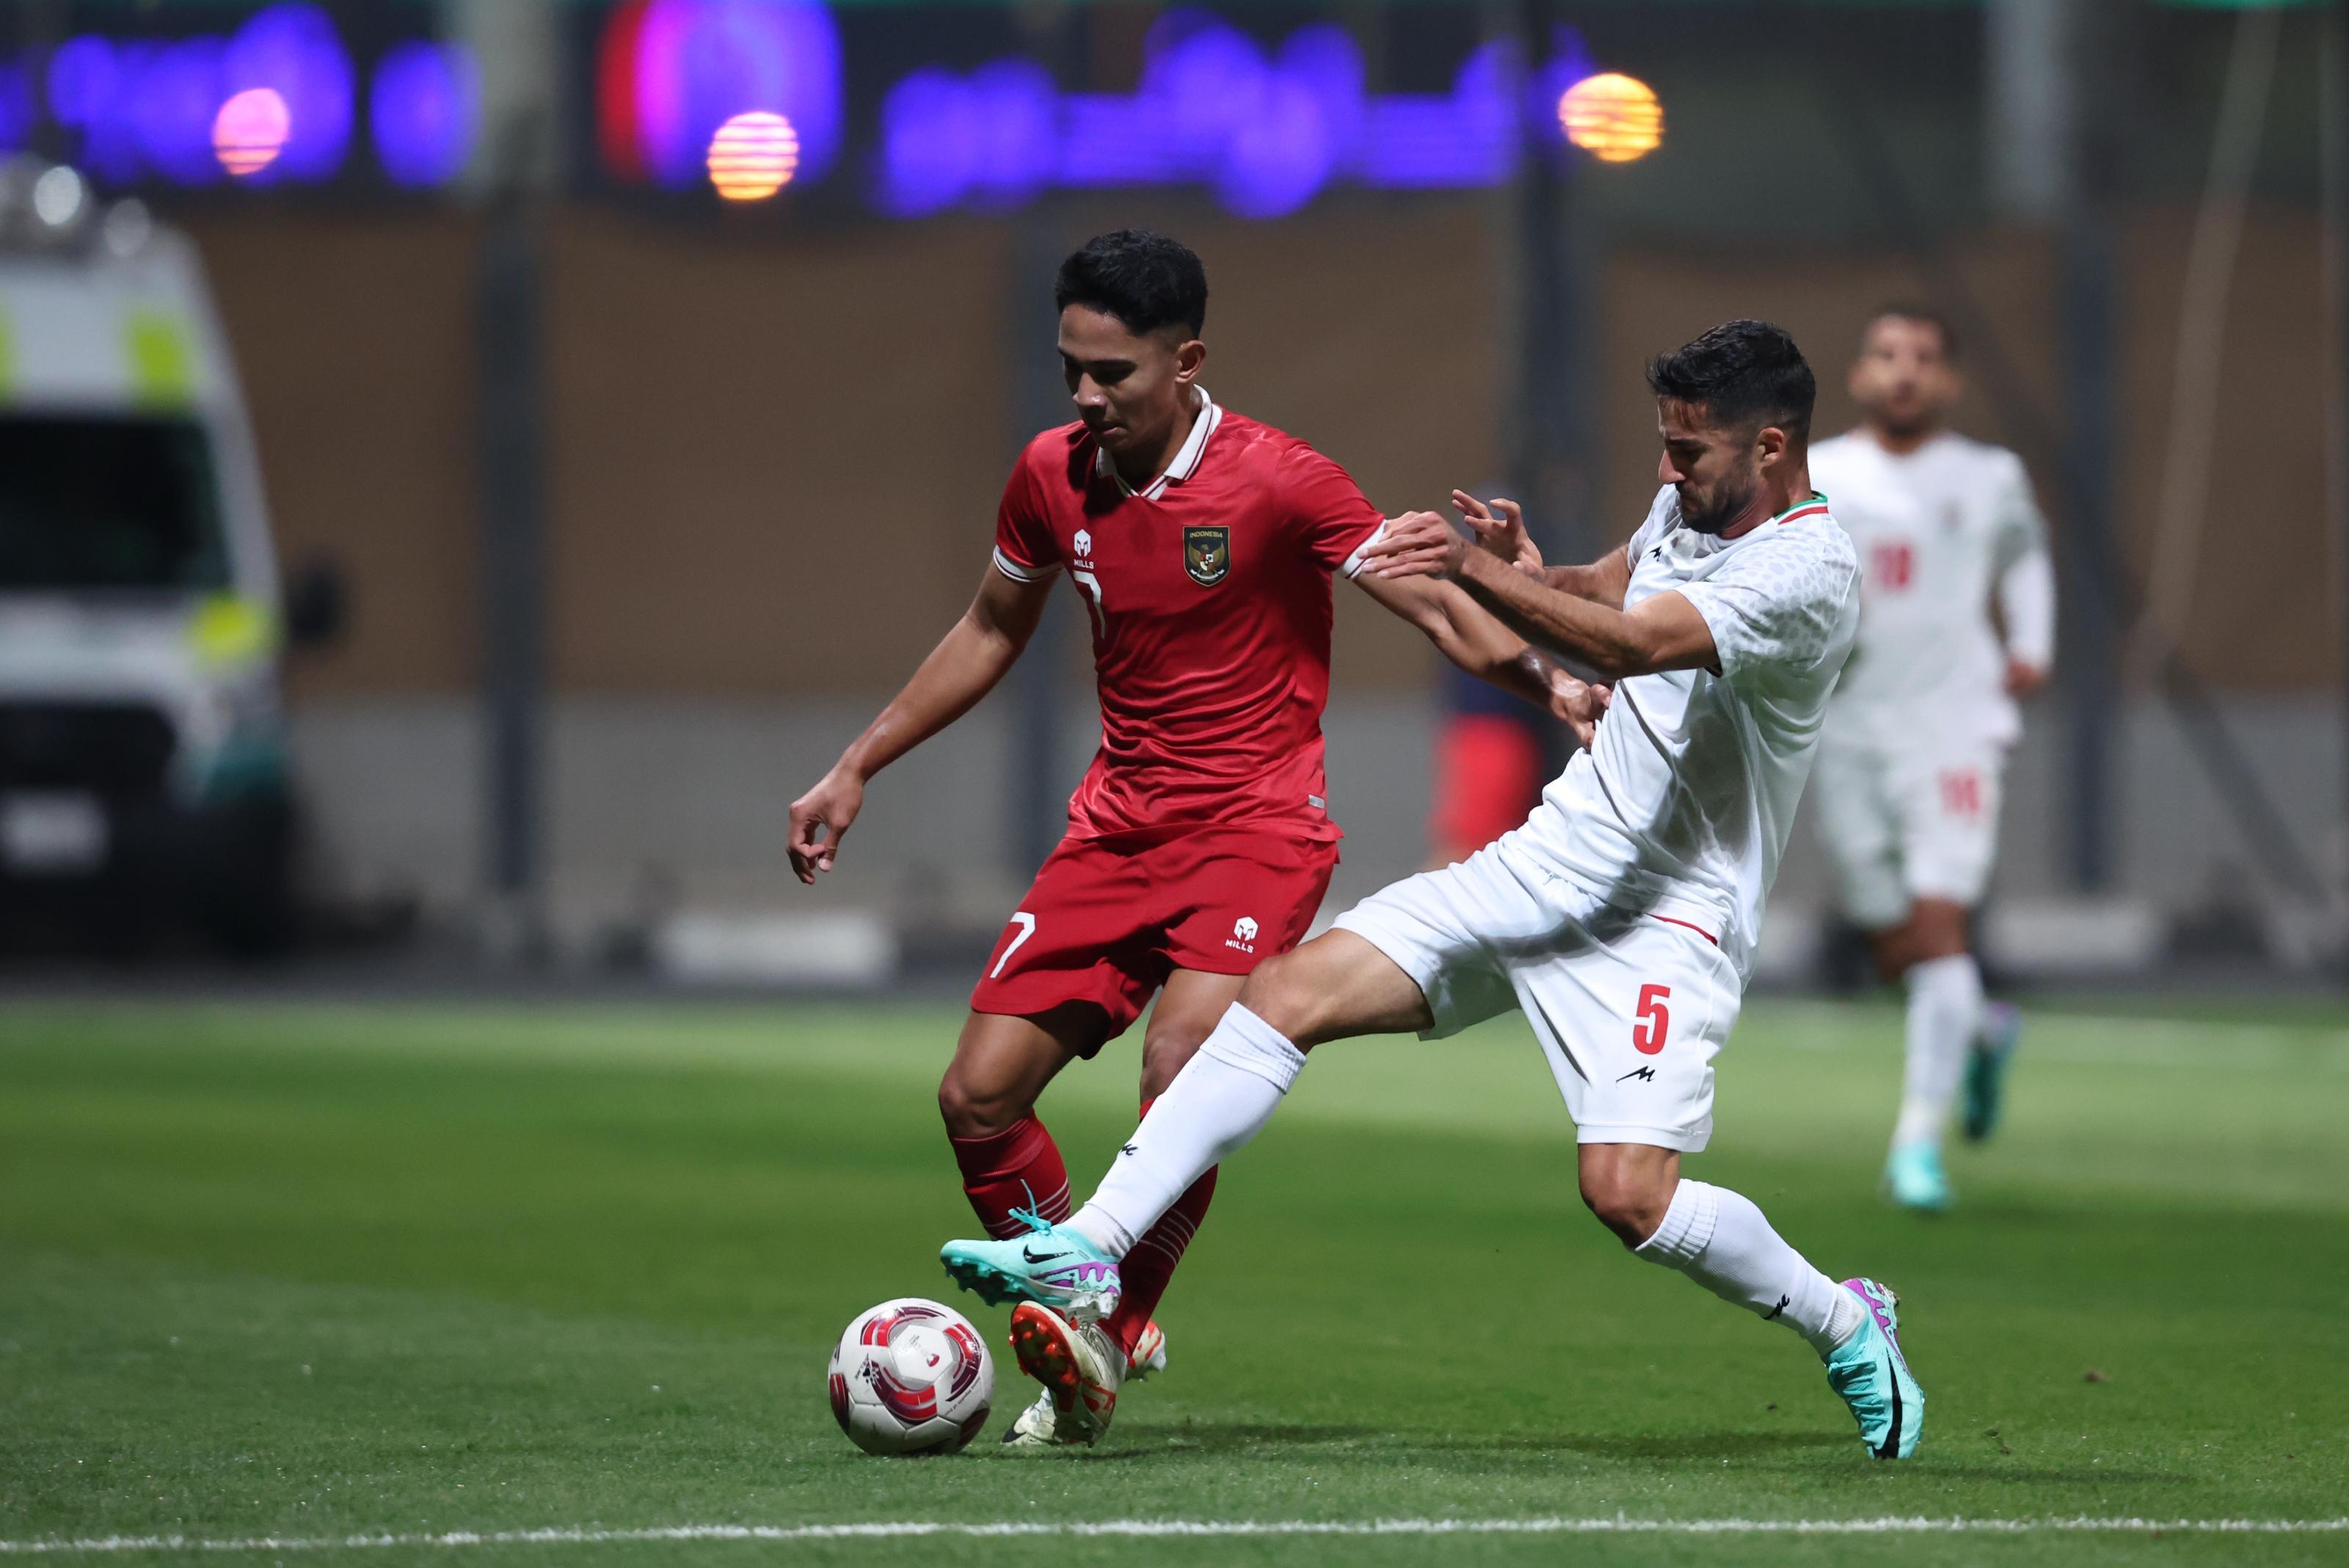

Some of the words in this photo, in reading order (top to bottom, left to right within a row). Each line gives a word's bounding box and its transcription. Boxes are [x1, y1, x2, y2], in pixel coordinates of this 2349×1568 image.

[1190, 530, 1223, 539] INDONESIA
[1074, 559, 1094, 569] MILLS
[990, 911, 1035, 978] 7
[1225, 939, 1254, 954] MILLS
[1632, 983, 1671, 1055] 5
